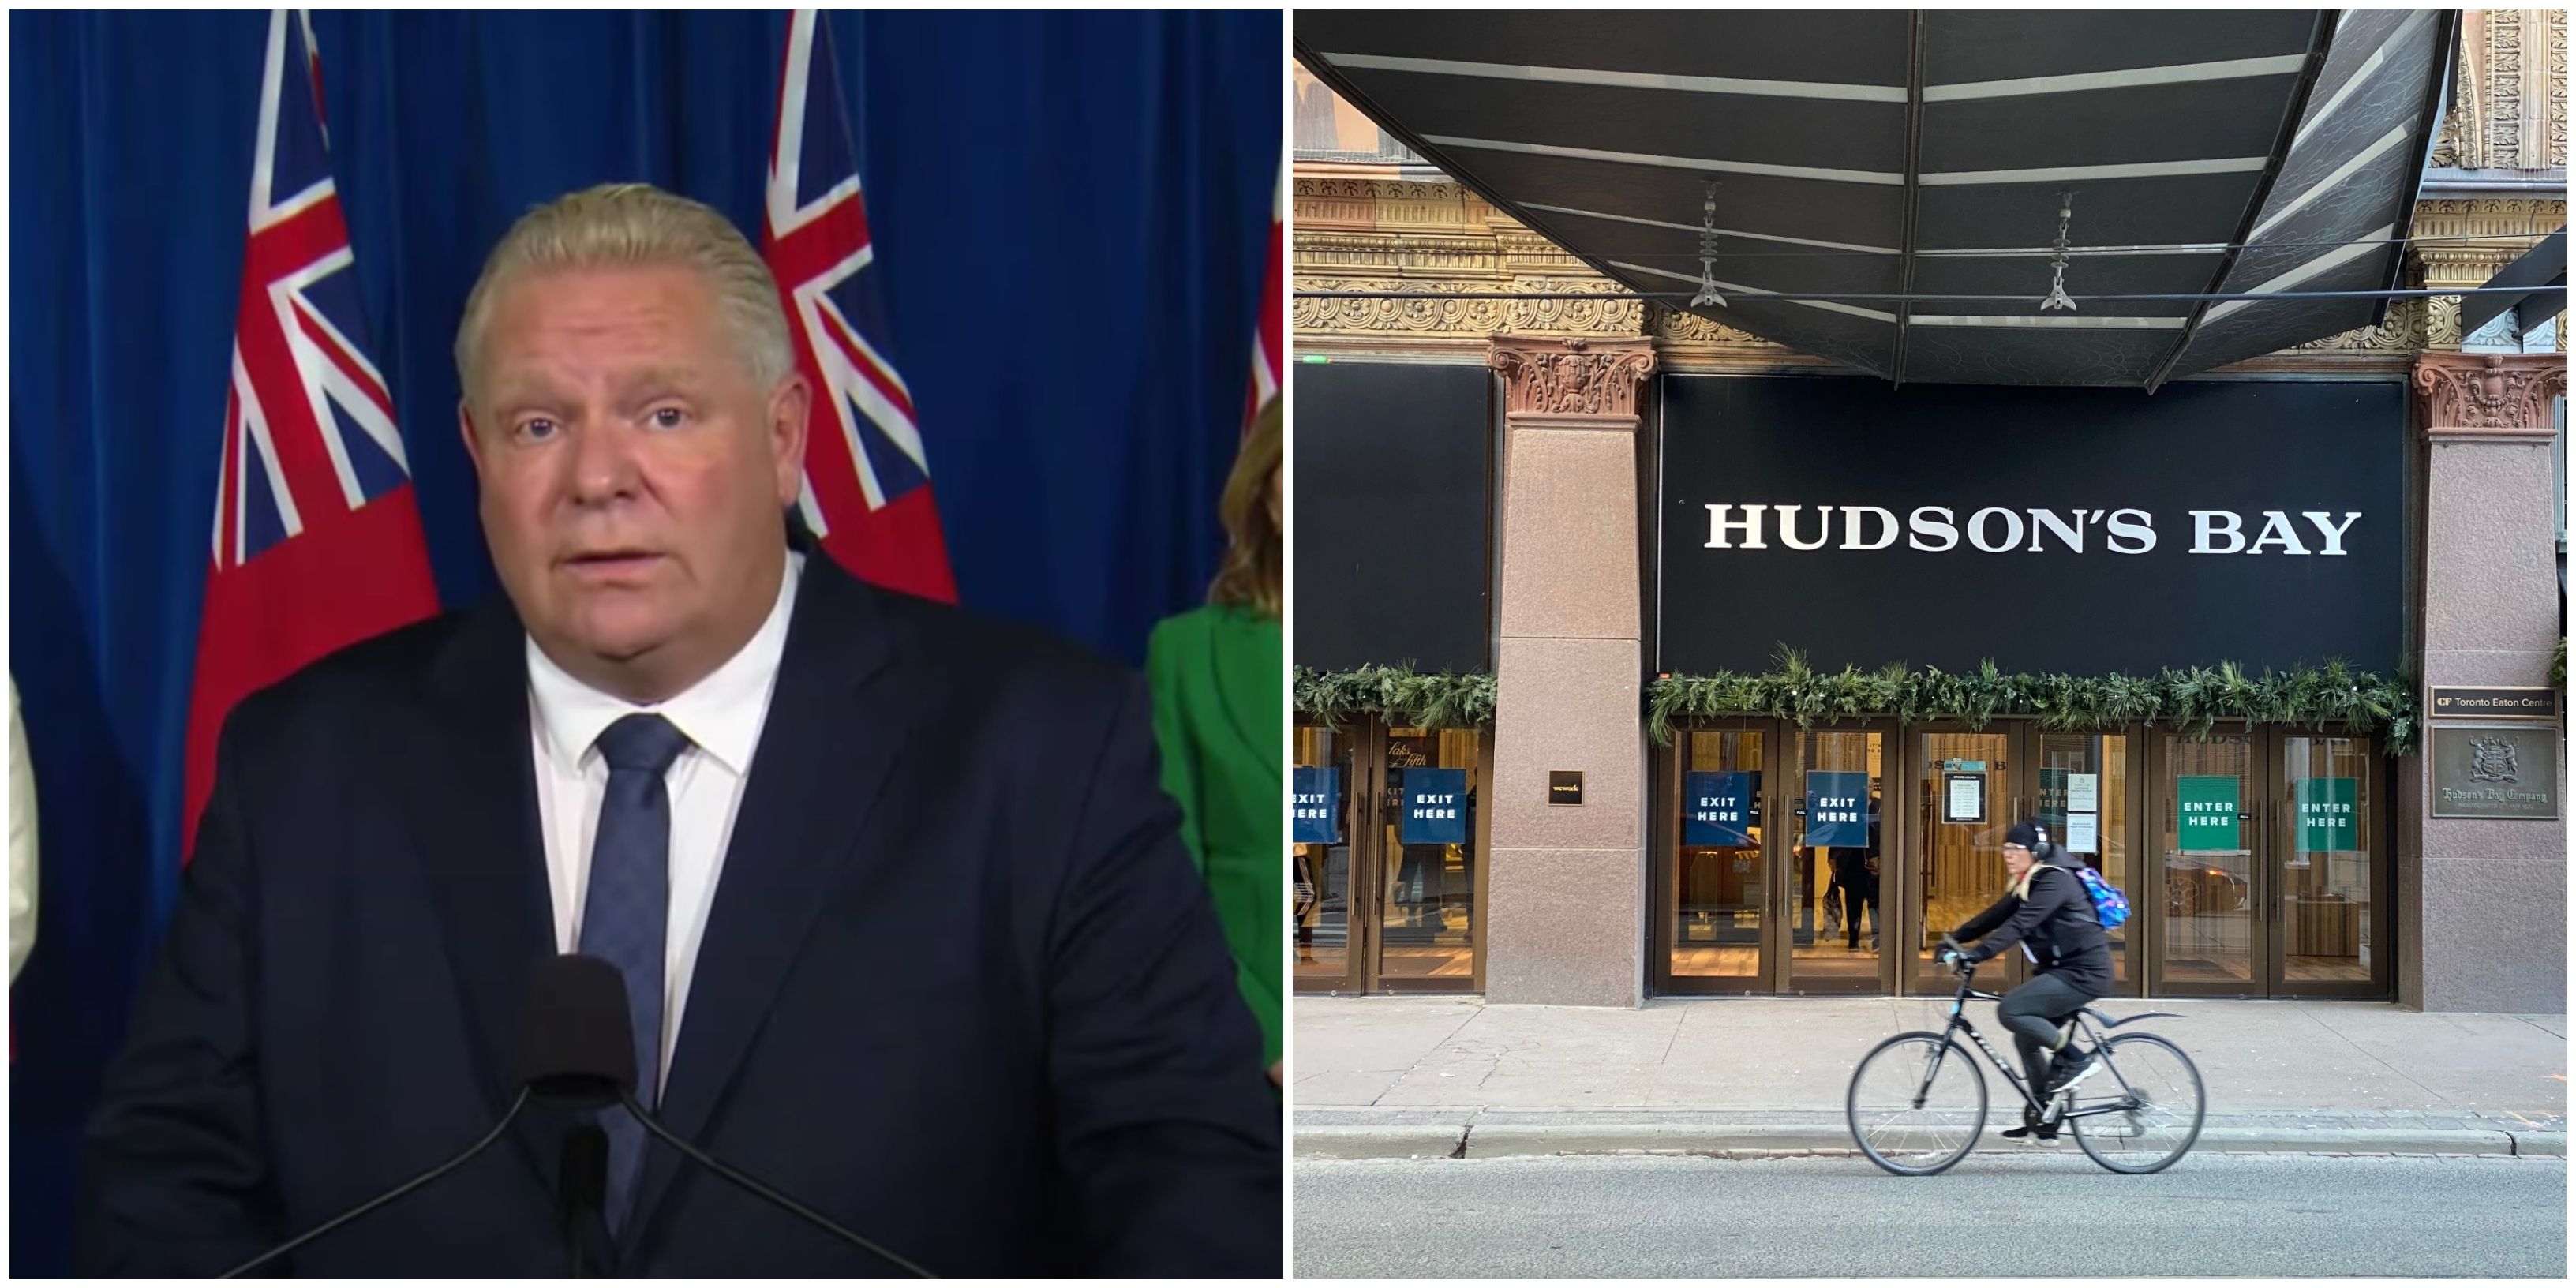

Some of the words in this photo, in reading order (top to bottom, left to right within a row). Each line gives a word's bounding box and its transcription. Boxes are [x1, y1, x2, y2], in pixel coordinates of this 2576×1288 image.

[1703, 504, 2157, 554] HUDSON'S
[2188, 510, 2362, 556] BAY
[2437, 698, 2452, 706] CF
[2455, 698, 2491, 707] Toronto
[2492, 698, 2520, 707] Eaton
[2522, 698, 2552, 708] Centre
[1417, 794, 1454, 803] EXIT
[2443, 788, 2484, 801] Hudson's
[2487, 789, 2505, 802] Bay
[2507, 789, 2548, 803] Company
[1700, 797, 1735, 807] EXIT
[1820, 797, 1855, 807] EXIT
[2184, 802, 2233, 811] ENTER
[2301, 803, 2350, 813] ENTER
[1293, 809, 1327, 818] ERE
[1413, 809, 1455, 818] HERE
[1698, 811, 1738, 821] HERE
[1817, 812, 1858, 822] HERE
[2188, 817, 2229, 826] HERE
[2306, 818, 2346, 827] HERE
